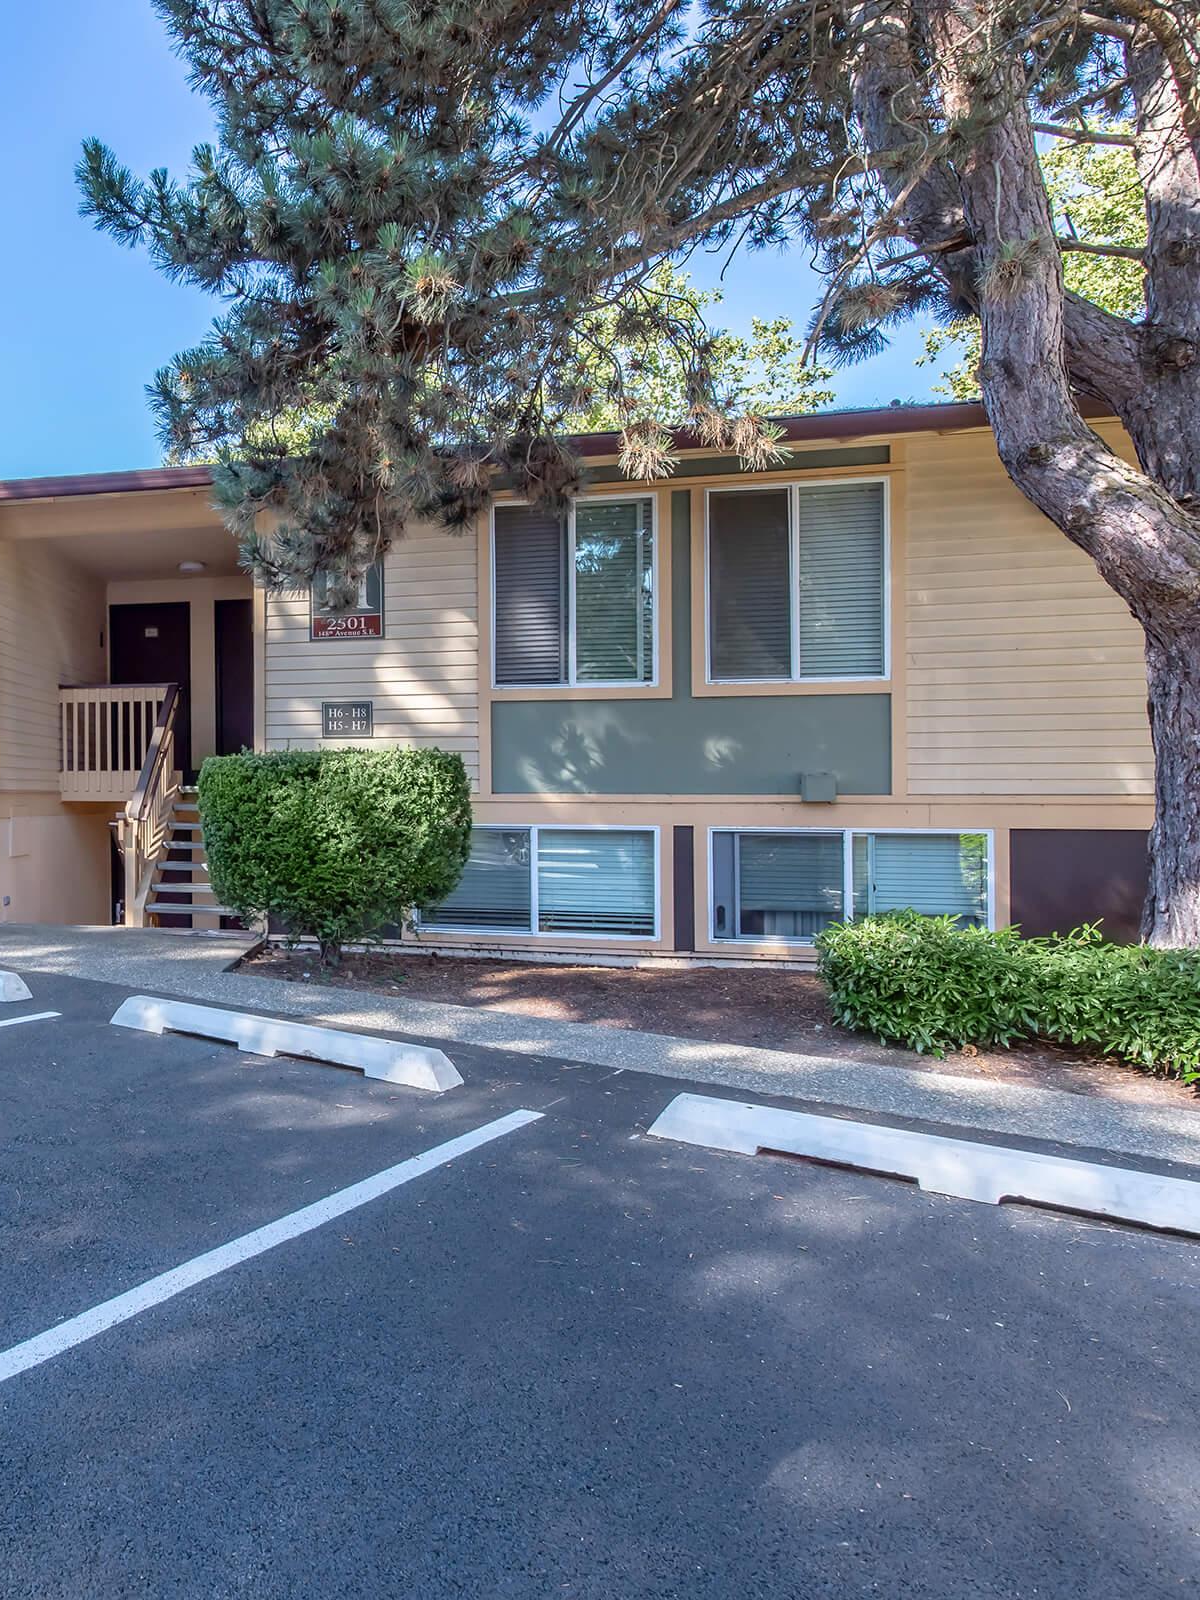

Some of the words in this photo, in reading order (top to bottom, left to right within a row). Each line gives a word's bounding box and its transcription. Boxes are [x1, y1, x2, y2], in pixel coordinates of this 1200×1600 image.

[327, 616, 366, 630] 2501
[328, 708, 343, 718] H6
[352, 707, 367, 718] H8
[328, 720, 343, 731] H5
[352, 720, 367, 731] H7
